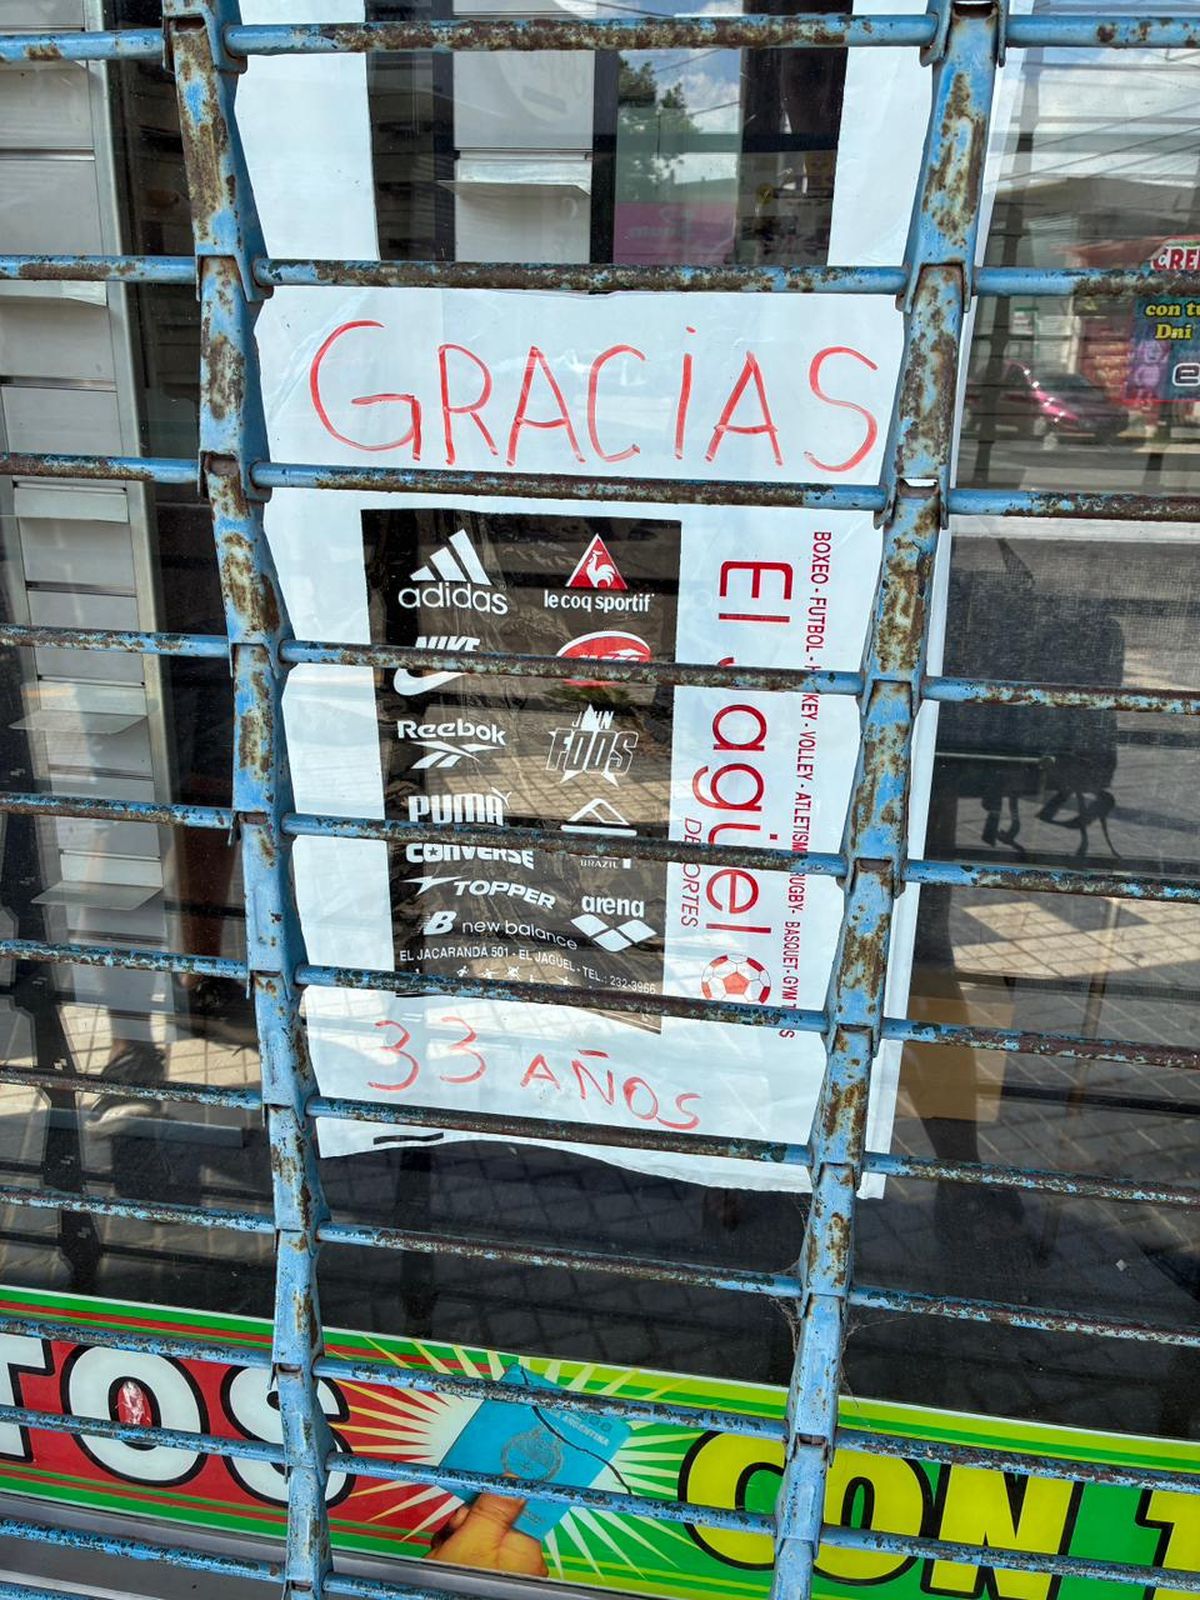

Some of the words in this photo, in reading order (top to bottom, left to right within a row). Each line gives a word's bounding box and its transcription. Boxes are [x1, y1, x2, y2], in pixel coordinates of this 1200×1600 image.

[1145, 304, 1181, 316] con
[1155, 323, 1192, 339] Dni
[811, 531, 831, 584] BOXEO
[398, 583, 508, 615] adidas
[544, 590, 559, 608] le
[560, 595, 592, 612] coq
[594, 593, 651, 613] sportif
[718, 560, 793, 623] El
[806, 597, 827, 653] FUTBOL
[801, 665, 821, 721] HKEY
[397, 718, 507, 746] Reebok
[797, 731, 816, 781] VOLLEY
[408, 792, 505, 827] PUMA
[406, 843, 535, 870] CONVERSE
[580, 859, 619, 869] BRAZIL
[681, 818, 702, 928] DEORTES
[453, 879, 556, 910] TOPPER
[581, 896, 645, 917] arena
[462, 918, 500, 933] new
[505, 918, 578, 951] balance
[400, 950, 414, 961] EL
[417, 946, 488, 960] JACARANDA
[492, 946, 509, 958] 501
[519, 949, 532, 960] EL
[610, 975, 656, 994] 232-3966
[367, 1015, 487, 1091] 33
[519, 1049, 702, 1130] AÑOS
